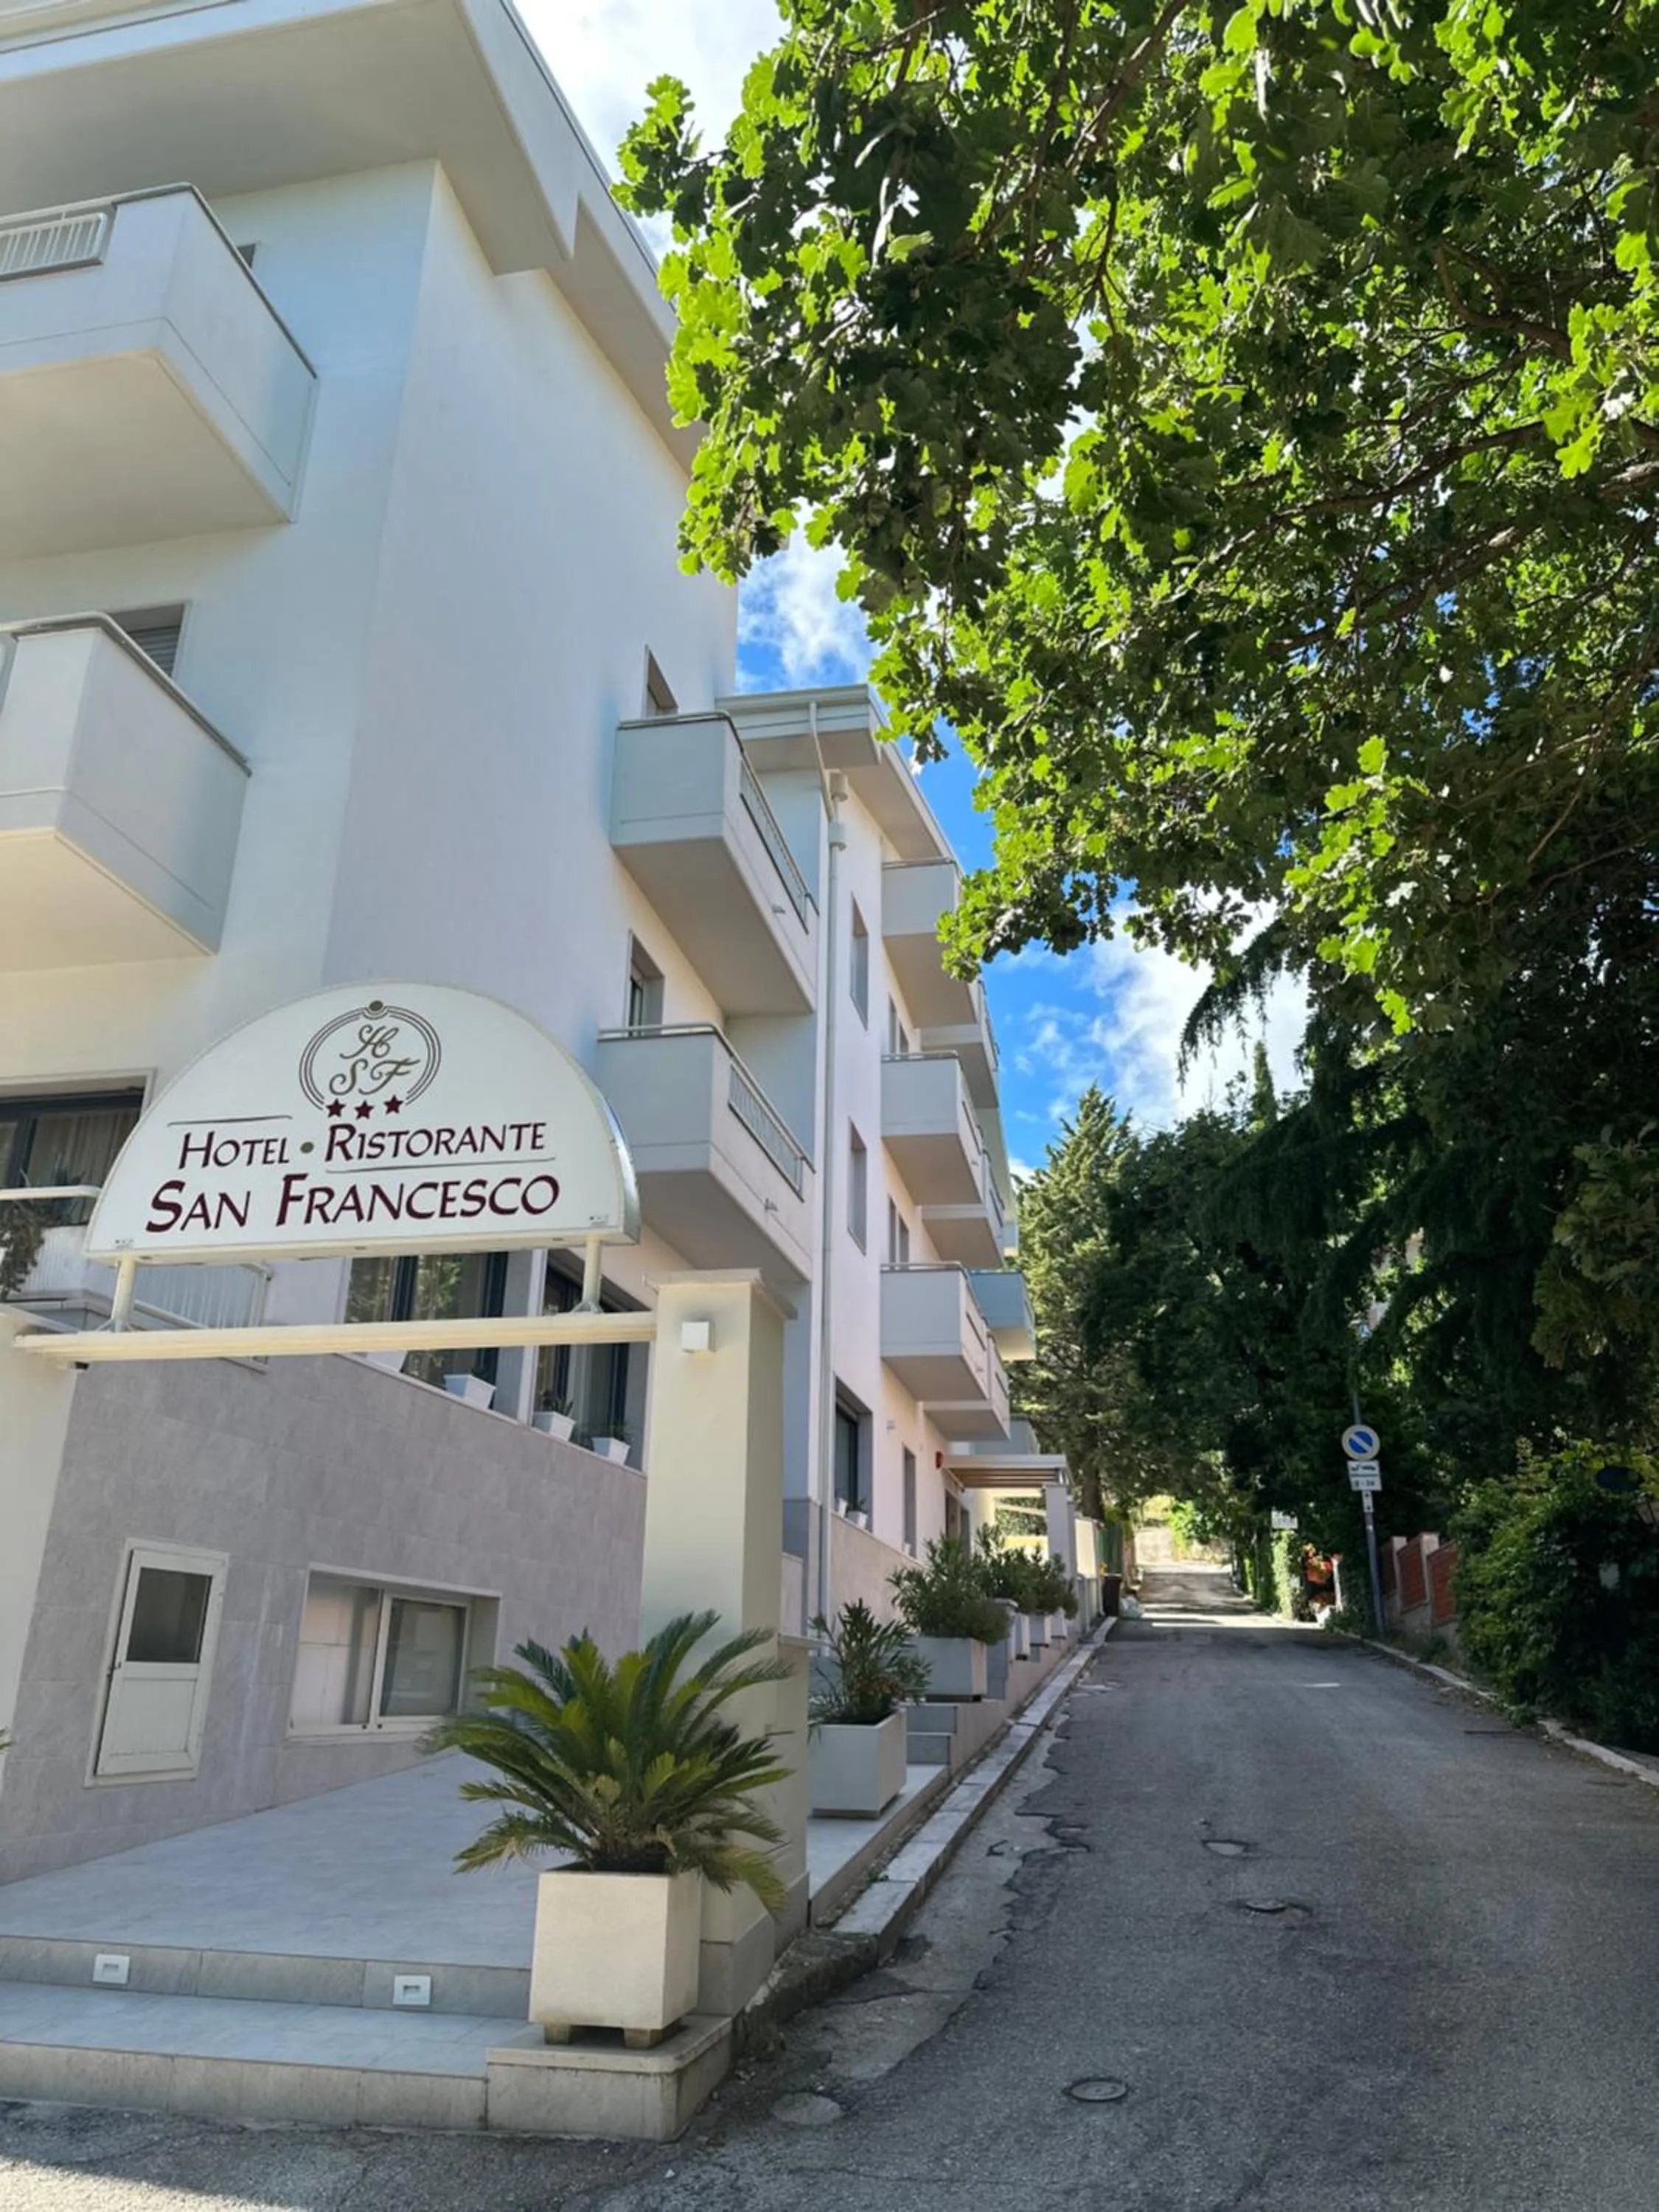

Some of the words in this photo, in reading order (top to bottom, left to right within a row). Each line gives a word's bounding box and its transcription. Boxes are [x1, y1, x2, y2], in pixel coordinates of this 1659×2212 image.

[178, 1130, 290, 1170] HOTEL
[324, 1121, 547, 1163] RISTORANTE
[145, 1179, 251, 1233] SAN
[275, 1172, 560, 1228] FRANCESCO
